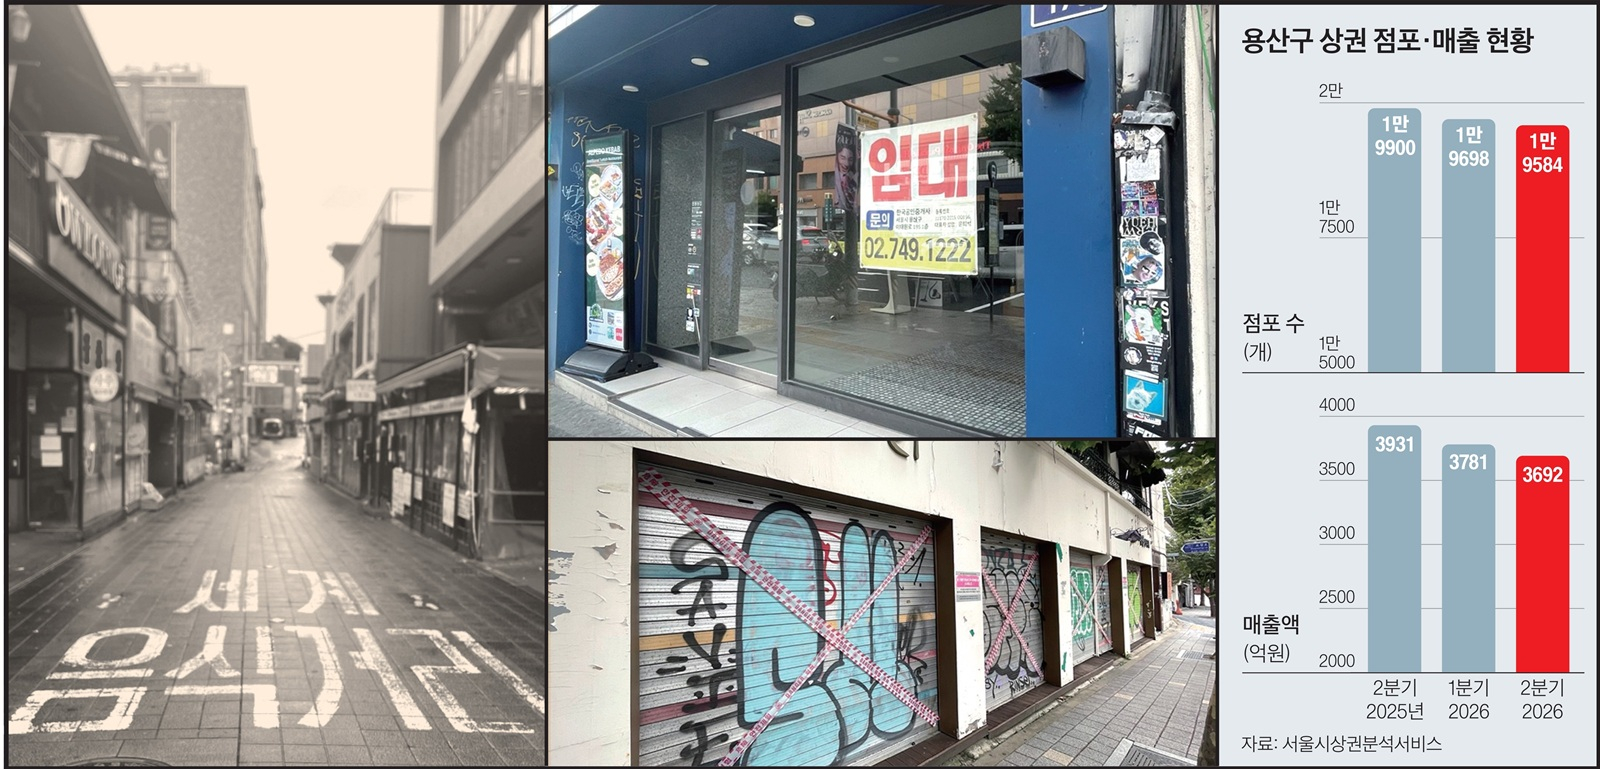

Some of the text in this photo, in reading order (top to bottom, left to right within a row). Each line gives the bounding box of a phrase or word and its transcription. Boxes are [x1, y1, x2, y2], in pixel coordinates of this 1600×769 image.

[869, 126, 969, 202] 임대
[865, 238, 971, 262] 02.749.1222
[870, 213, 890, 228] 문의
[659, 487, 690, 515] 안전제일
[706, 528, 733, 552] DANGER
[794, 603, 813, 621] DANGER
[173, 569, 379, 615] 세계
[9, 625, 545, 733] 음식거리
